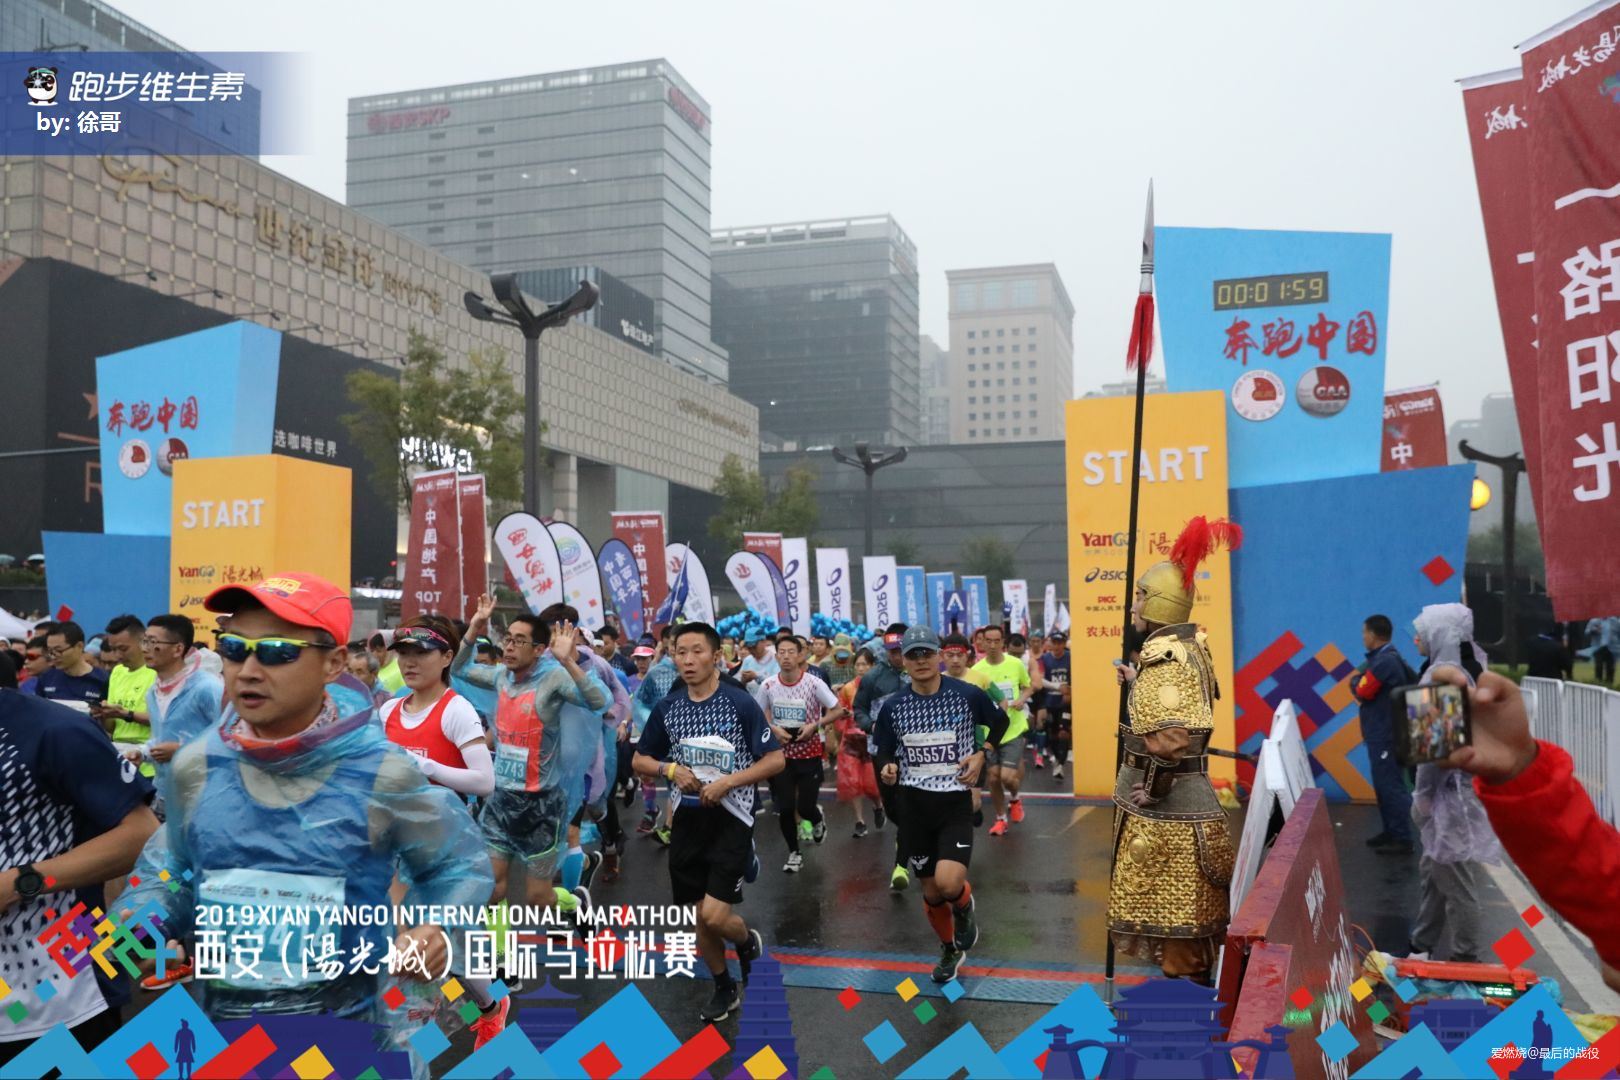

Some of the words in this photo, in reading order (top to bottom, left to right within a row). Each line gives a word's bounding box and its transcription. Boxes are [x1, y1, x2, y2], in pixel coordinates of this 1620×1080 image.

[1217, 277, 1324, 305] 00:01:59
[1223, 310, 1377, 366] 奔跑中国
[106, 395, 200, 437] 奔跑中国
[1083, 446, 1209, 486] START
[181, 499, 265, 530] START
[1086, 625, 1124, 638] 农夫山
[774, 708, 804, 720] B11282
[683, 747, 731, 770] B10560
[907, 745, 956, 763] B55575
